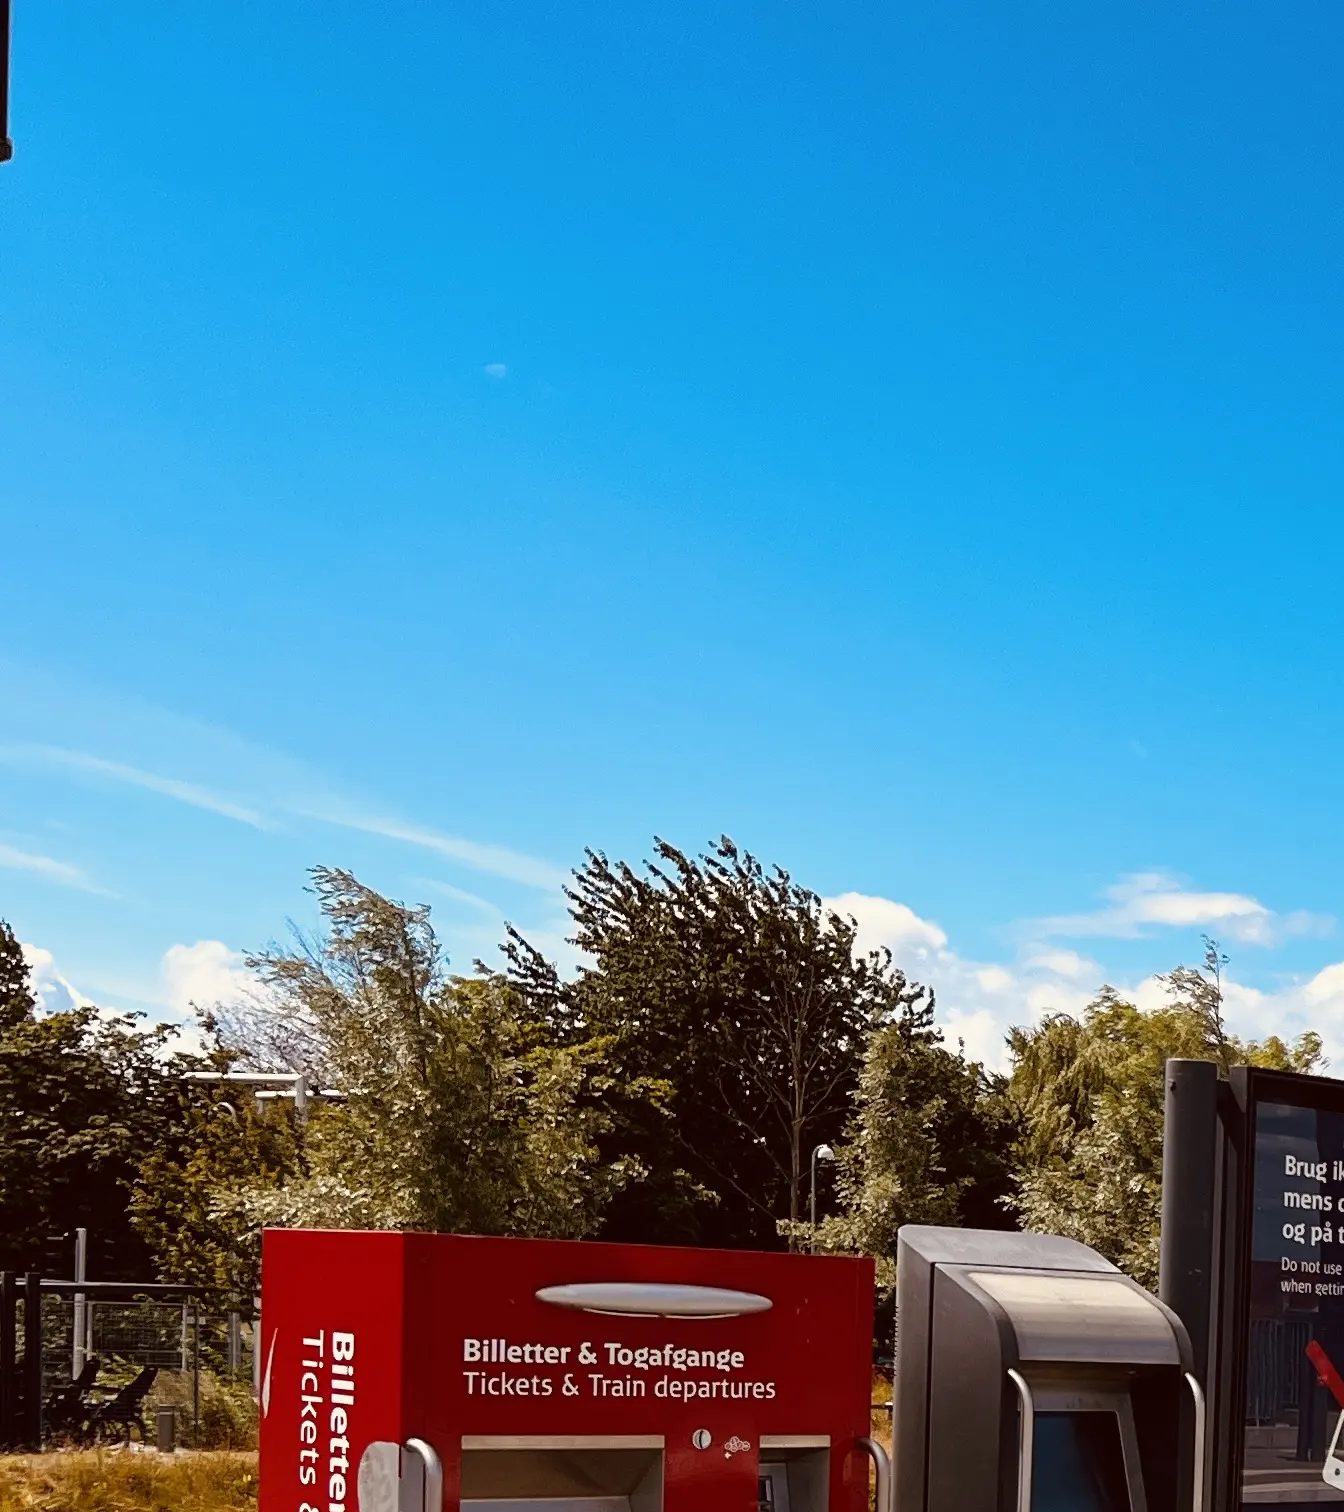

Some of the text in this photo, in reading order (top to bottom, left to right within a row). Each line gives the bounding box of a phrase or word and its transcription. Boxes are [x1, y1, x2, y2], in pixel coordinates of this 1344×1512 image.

[1285, 1155, 1327, 1183] Brug
[1283, 1191, 1332, 1211] mens
[1282, 1222, 1305, 1244] og
[1310, 1221, 1333, 1246] på
[1281, 1257, 1297, 1272] Do
[1301, 1261, 1320, 1274] not
[1323, 1263, 1342, 1275] use
[1281, 1278, 1311, 1294] when
[463, 1338, 745, 1372] Billetter & Togafgange
[463, 1371, 776, 1403] Tickets & Train departures
[299, 1329, 324, 1485] Tickets
